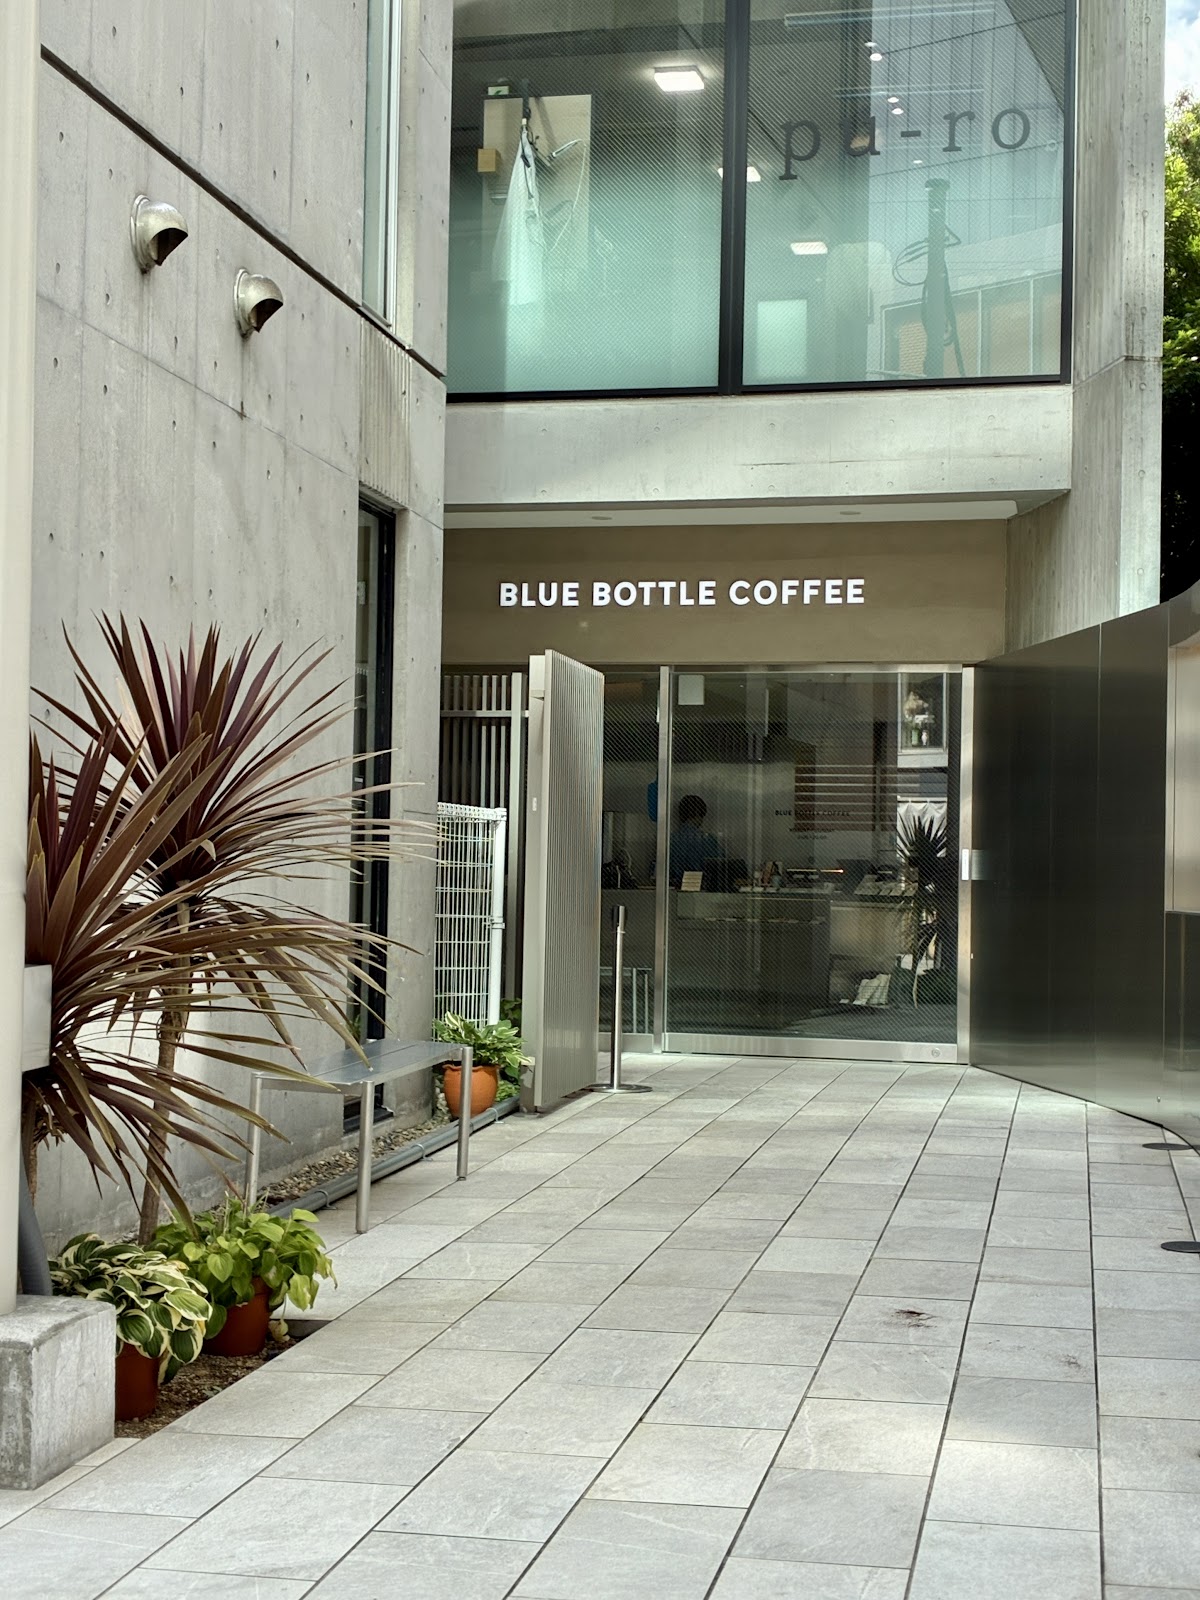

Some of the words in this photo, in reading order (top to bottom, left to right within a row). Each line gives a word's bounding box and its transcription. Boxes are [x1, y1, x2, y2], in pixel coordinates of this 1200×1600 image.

[499, 582, 578, 607] BLUE
[593, 580, 716, 607] BOTTLE
[729, 578, 865, 605] COFFEE
